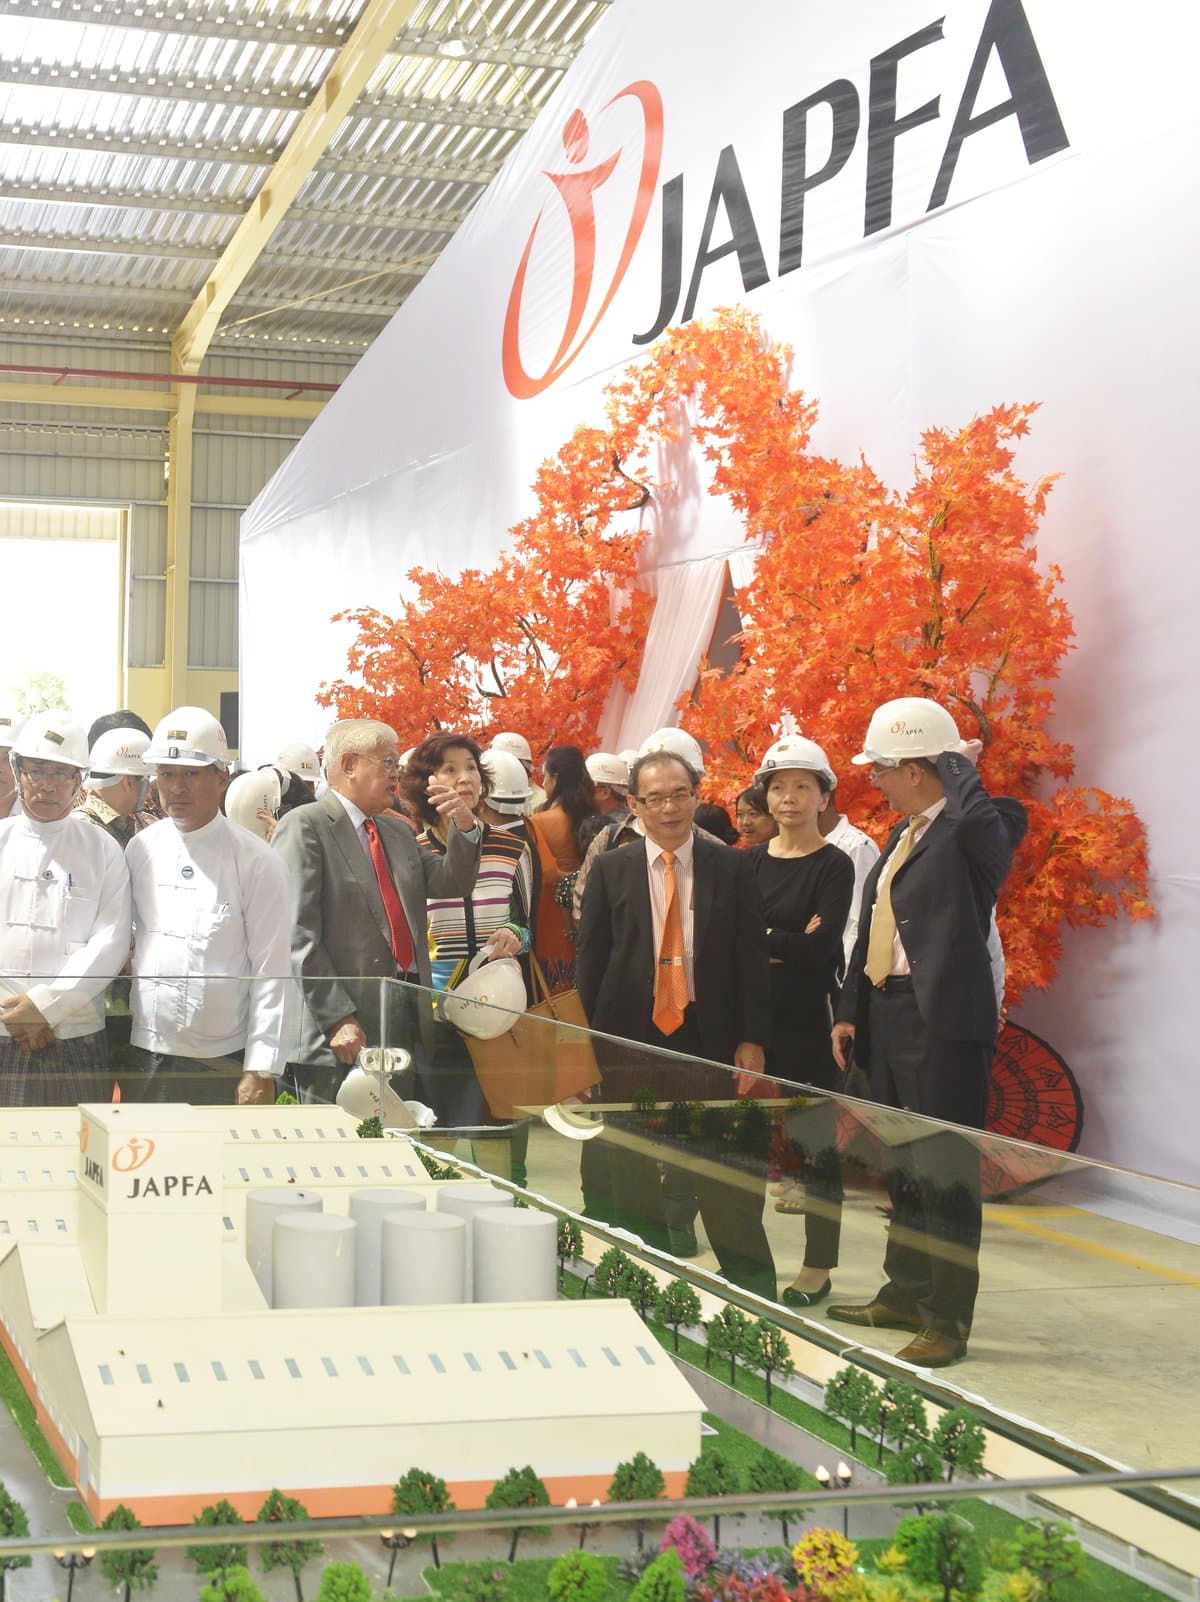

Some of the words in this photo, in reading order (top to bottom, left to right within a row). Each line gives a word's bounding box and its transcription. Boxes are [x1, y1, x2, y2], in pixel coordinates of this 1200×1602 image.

[632, 0, 1071, 345] JAPFA
[84, 1156, 104, 1189] JAPFA
[127, 1175, 213, 1199] JAPFA
